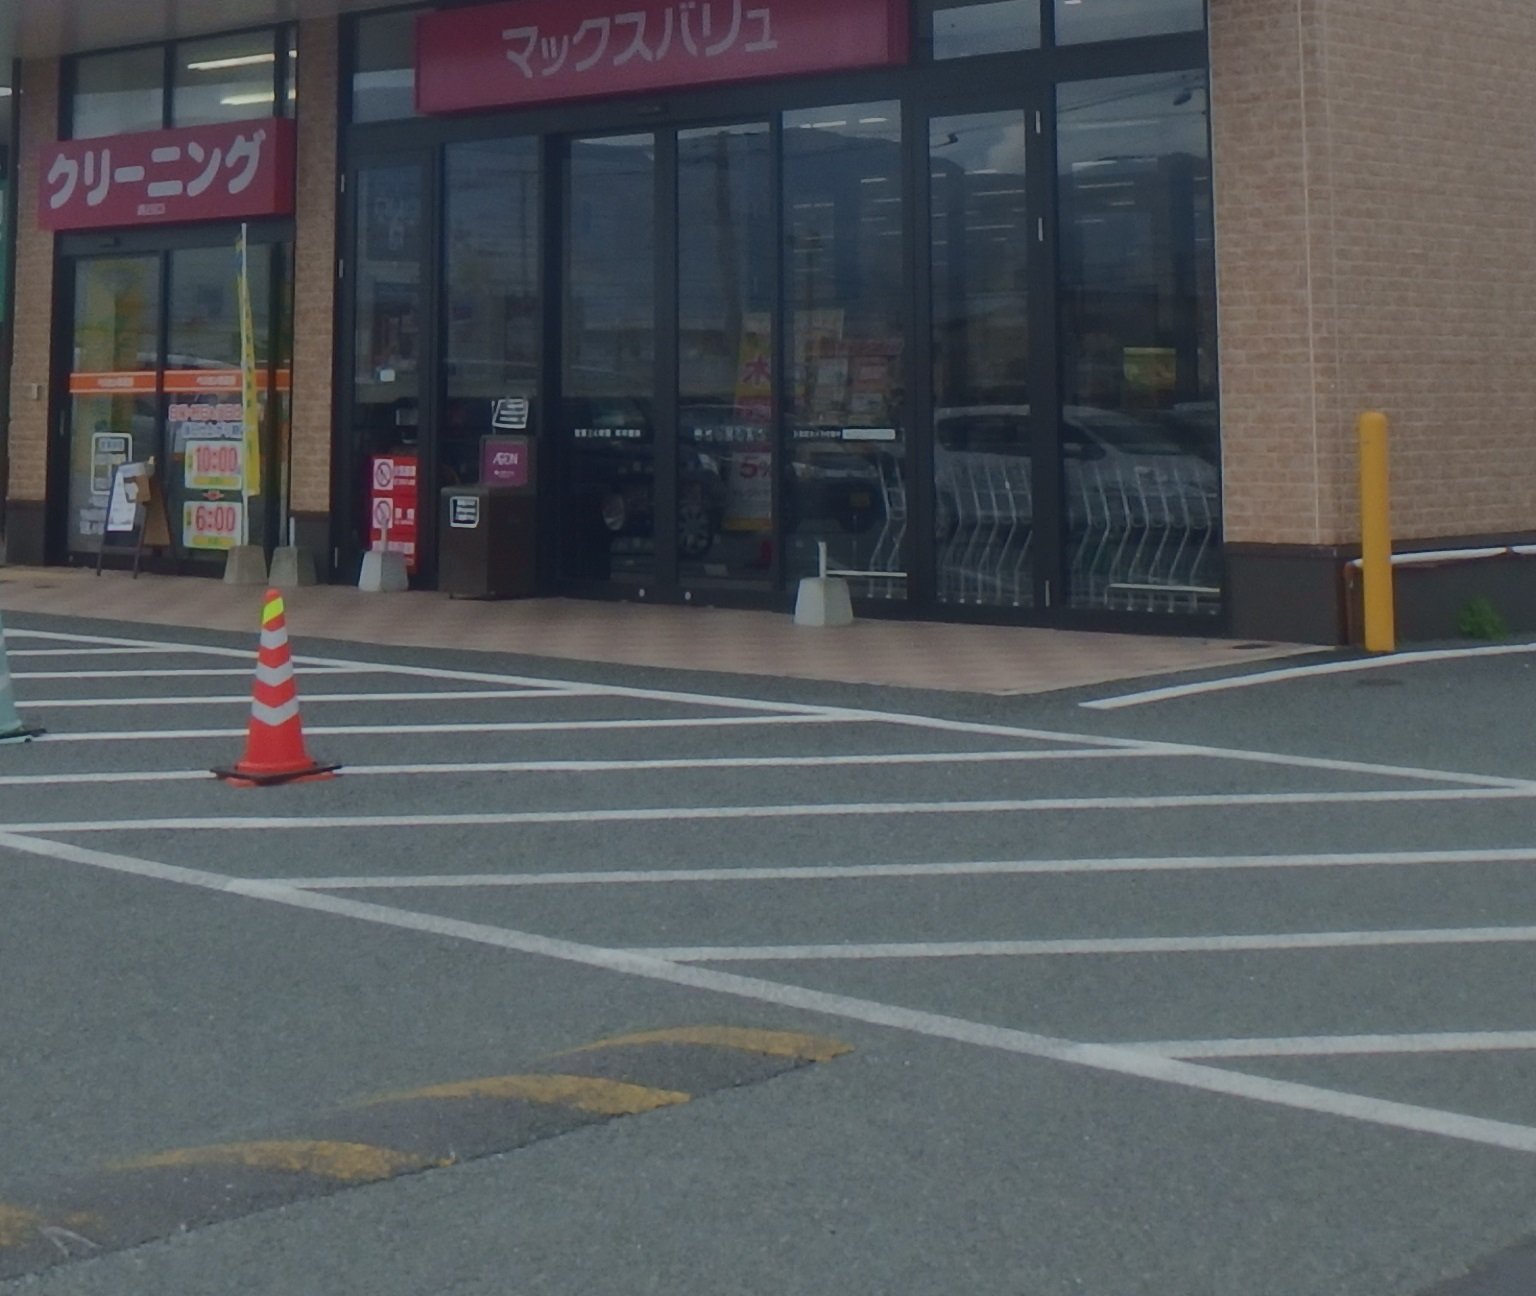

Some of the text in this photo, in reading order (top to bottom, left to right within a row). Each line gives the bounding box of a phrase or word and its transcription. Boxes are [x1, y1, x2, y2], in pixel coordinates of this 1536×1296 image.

[47, 128, 267, 210] クリーニング
[195, 446, 238, 473] 10:00
[195, 505, 236, 532] 6:00
